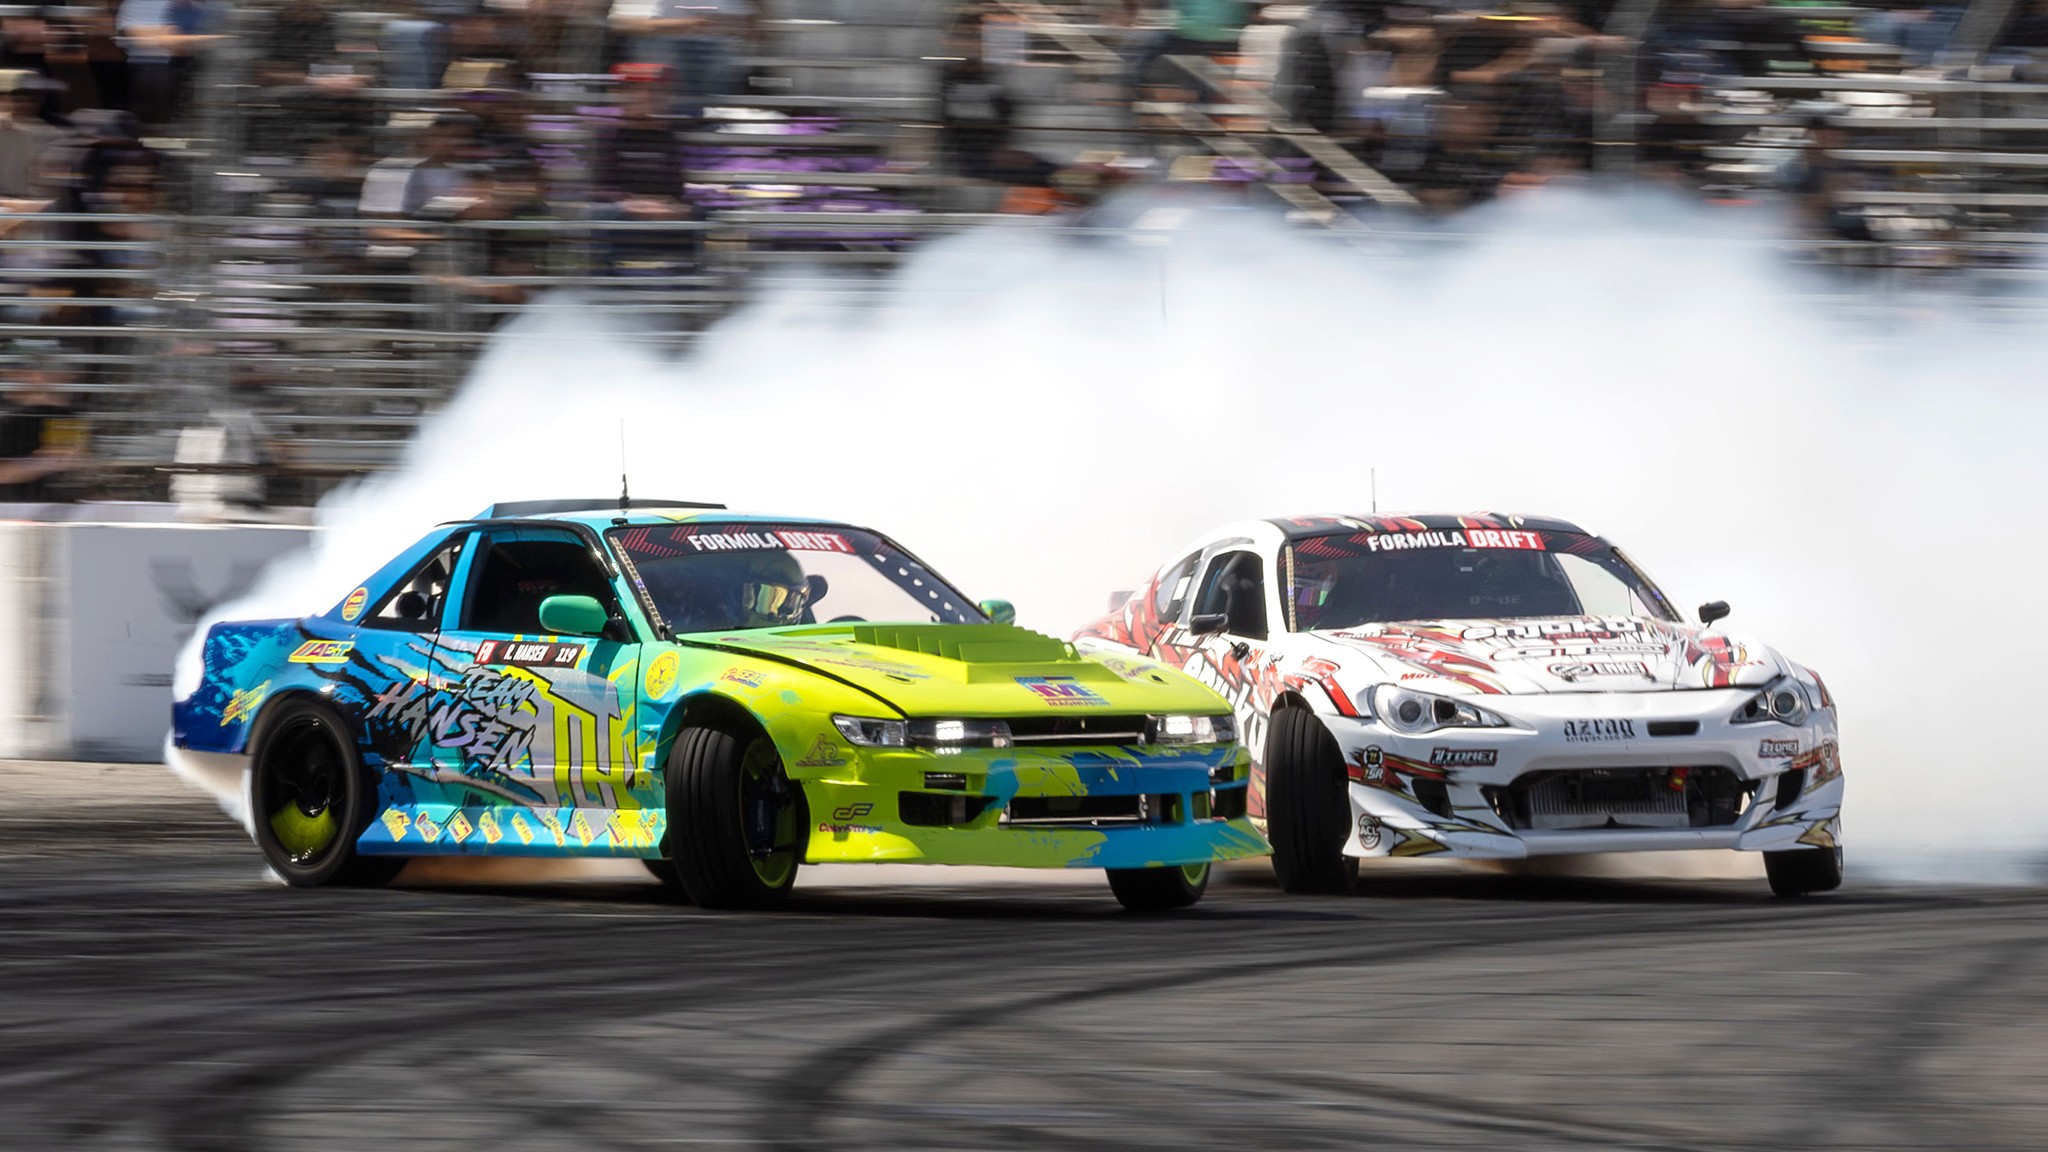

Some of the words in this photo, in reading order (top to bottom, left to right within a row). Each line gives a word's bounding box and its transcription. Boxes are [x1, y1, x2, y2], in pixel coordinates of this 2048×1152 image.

[687, 532, 784, 551] FORMULA
[780, 531, 849, 552] DRIFT
[1367, 531, 1467, 551] FORMULA
[1468, 529, 1539, 549] DRIFT
[475, 642, 497, 662] FD
[503, 643, 516, 660] R.
[513, 644, 550, 661] HANSEN
[555, 647, 578, 663] 119
[466, 667, 538, 715] TEAM
[365, 681, 537, 777] HANSEN
[1360, 825, 1379, 837] ACL
